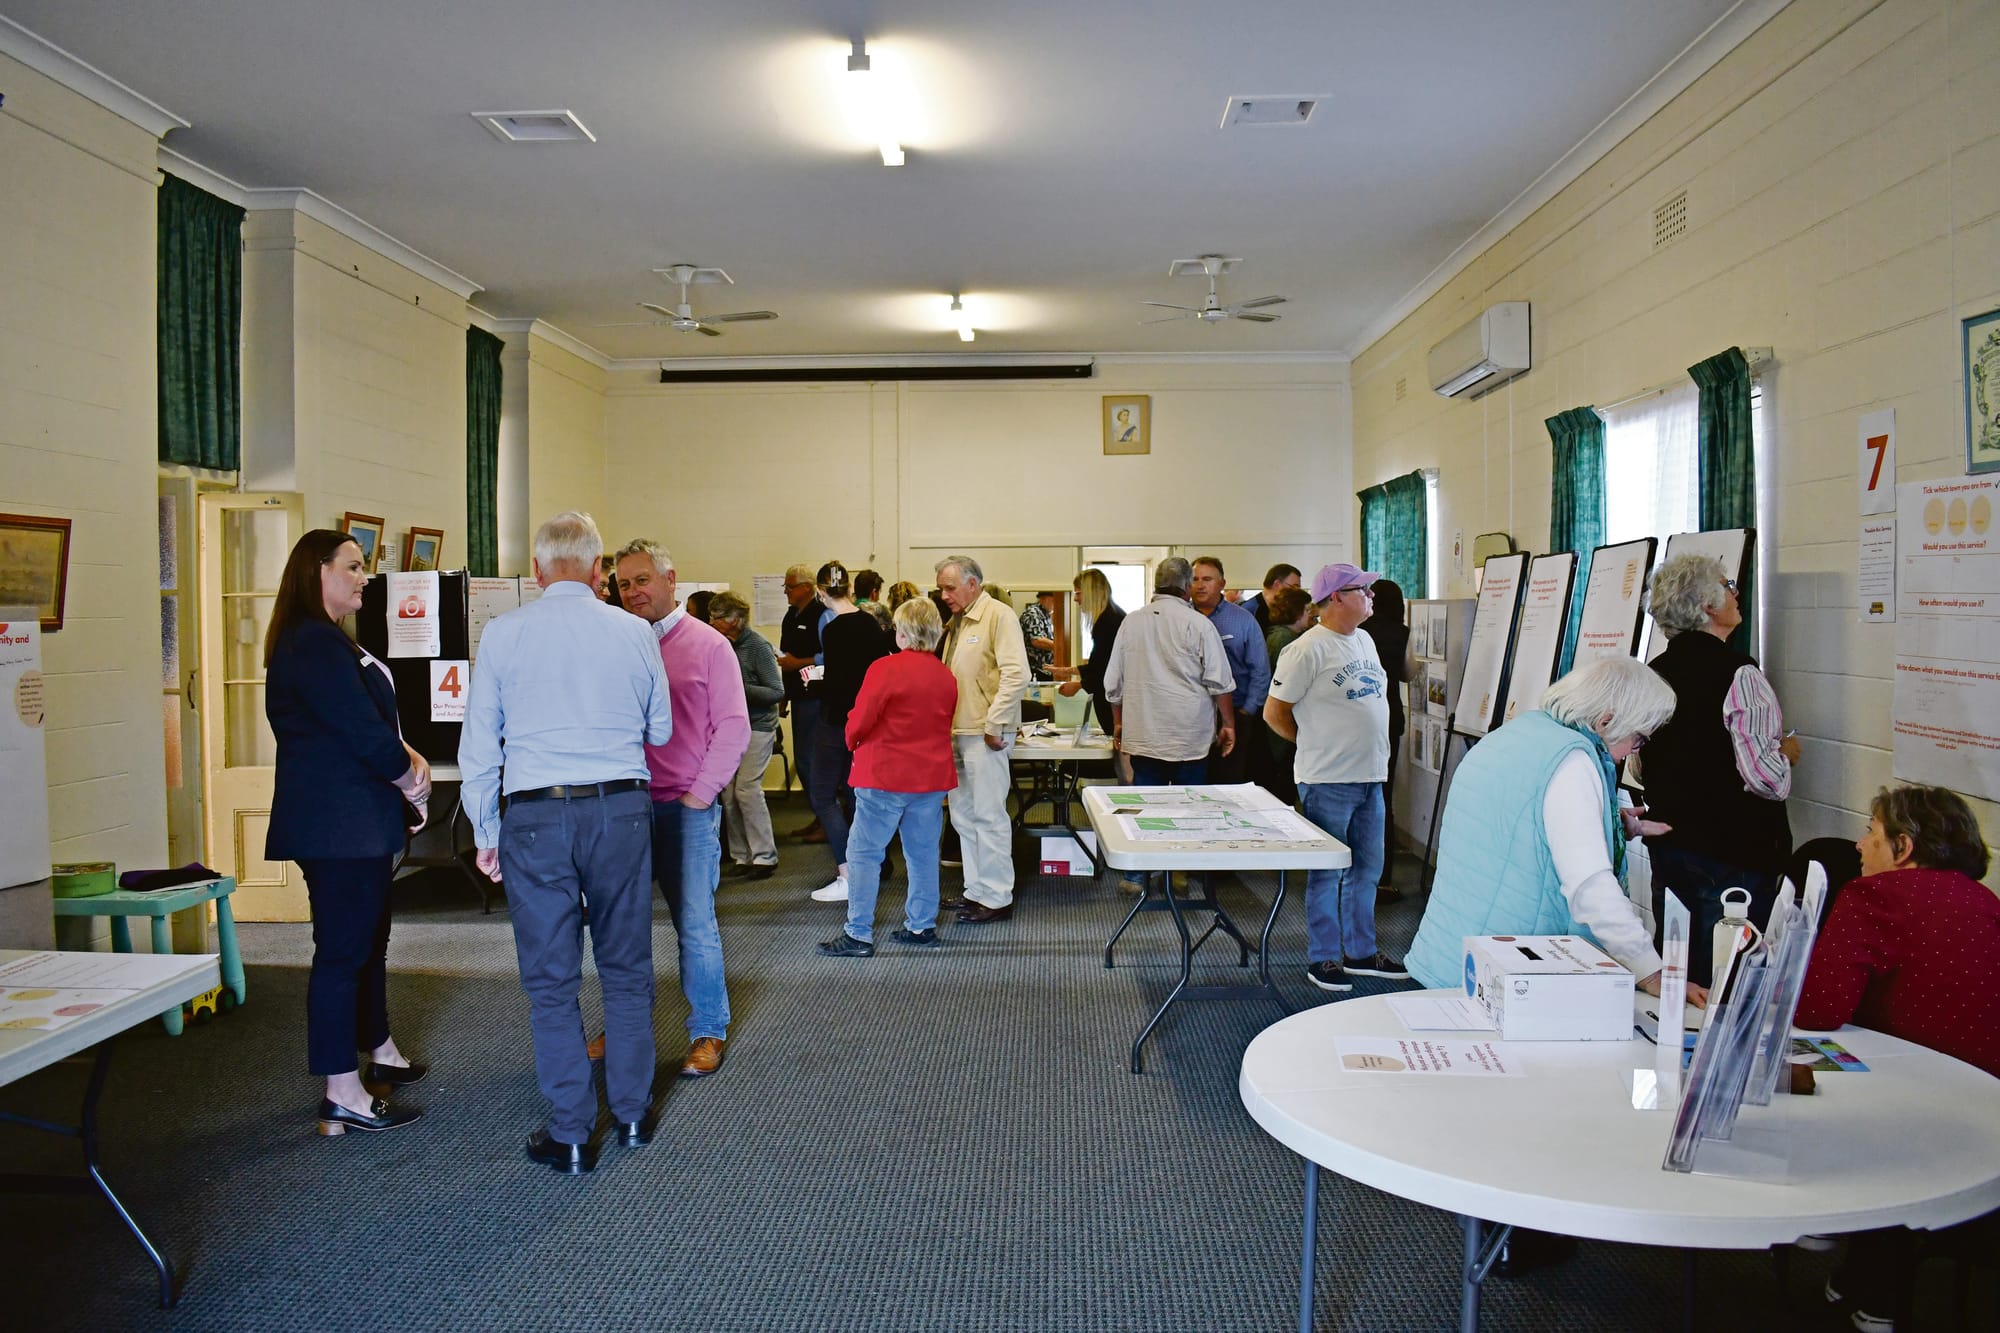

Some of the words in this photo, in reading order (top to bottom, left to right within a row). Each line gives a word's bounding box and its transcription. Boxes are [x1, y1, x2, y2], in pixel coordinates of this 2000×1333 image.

[1866, 434, 1889, 491] 7
[1962, 484, 1970, 492] you
[1922, 542, 1938, 550] Would
[1958, 541, 1966, 550] this
[1967, 540, 1986, 549] service?
[1930, 598, 1942, 606] often
[1943, 599, 1958, 607] would
[15, 634, 30, 644] and
[1332, 672, 1346, 688] AIR
[1342, 660, 1362, 676] FORCE
[1908, 664, 1921, 672] down
[1922, 665, 1932, 674] what
[1944, 668, 1958, 676] would
[1968, 670, 1976, 678] this
[438, 666, 462, 698] 4
